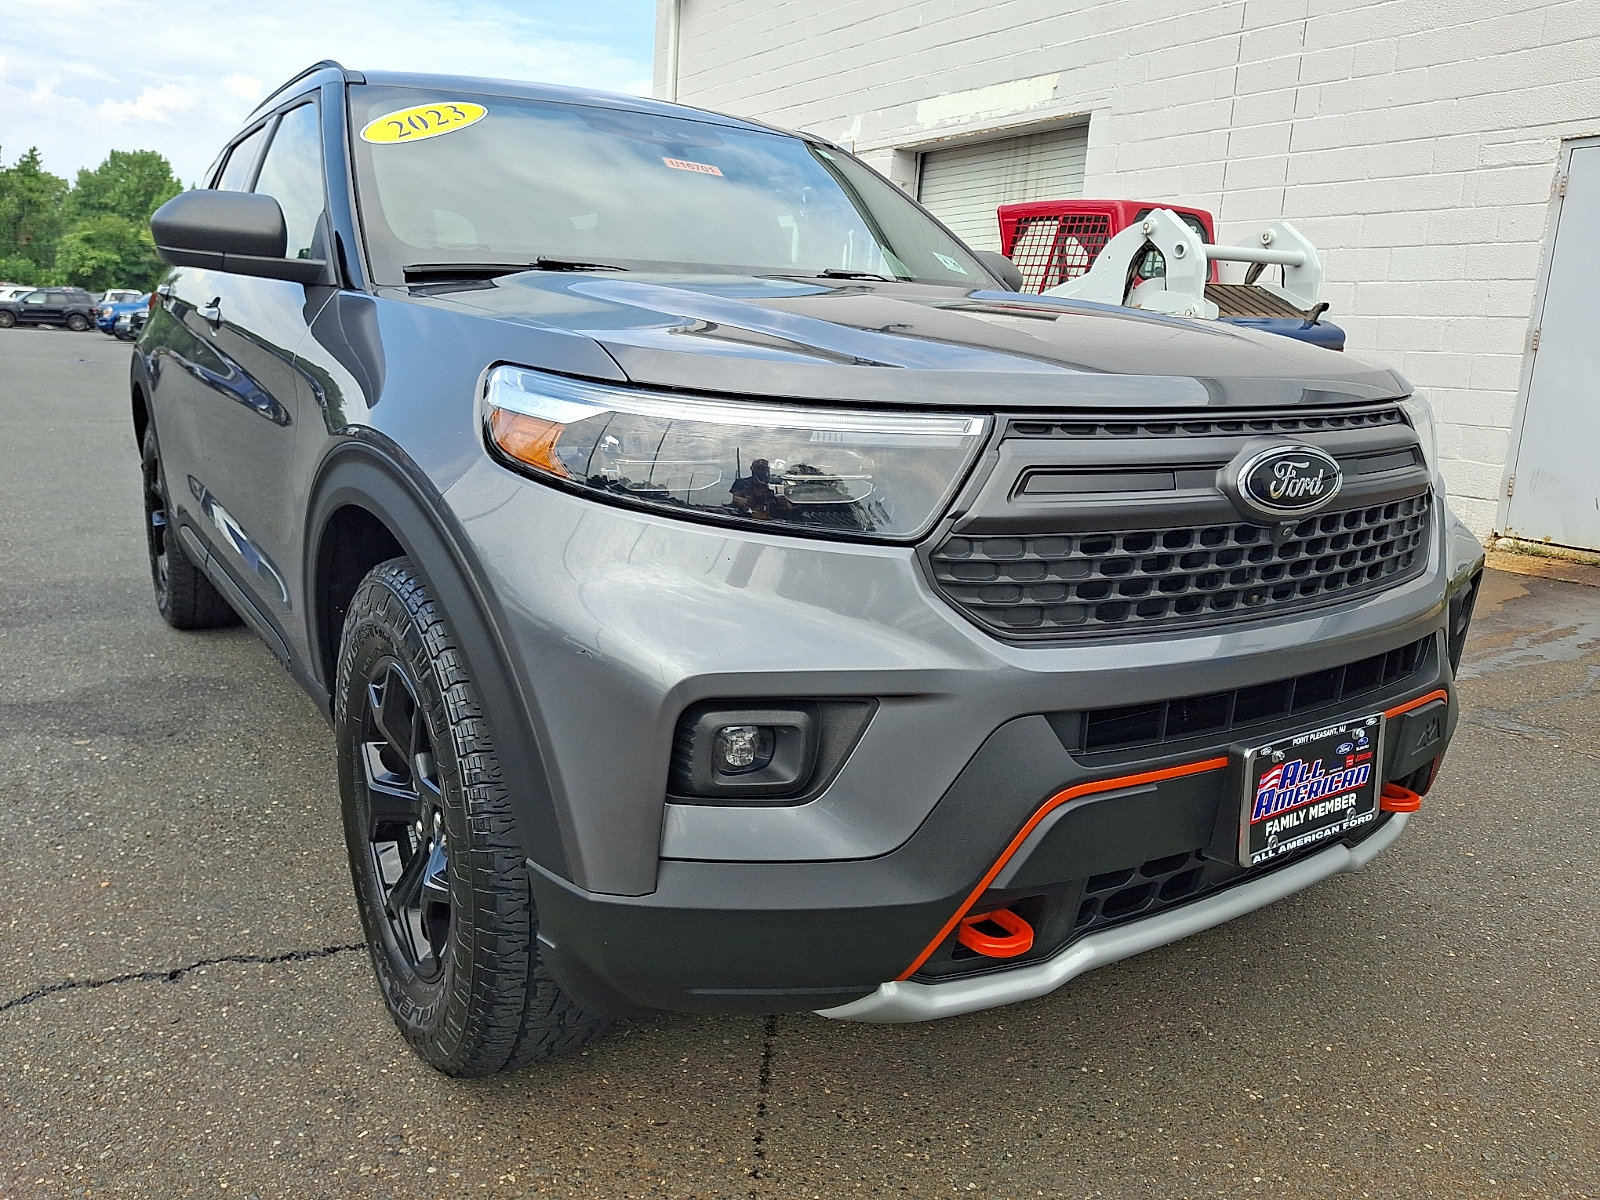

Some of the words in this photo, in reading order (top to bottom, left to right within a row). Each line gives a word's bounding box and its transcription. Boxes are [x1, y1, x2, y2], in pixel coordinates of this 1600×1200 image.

[387, 105, 466, 138] 2023
[669, 159, 716, 174] U16701
[1269, 461, 1324, 499] Ford
[1292, 733, 1309, 746] POINT
[1252, 763, 1370, 821] AMERICAN
[1278, 758, 1325, 792] ALL
[1265, 809, 1307, 836] FAMILY
[1309, 793, 1357, 820] MEMBER
[1252, 851, 1276, 864] ALL
[1279, 826, 1340, 853] AMERICAN
[1342, 814, 1373, 830] FORD
